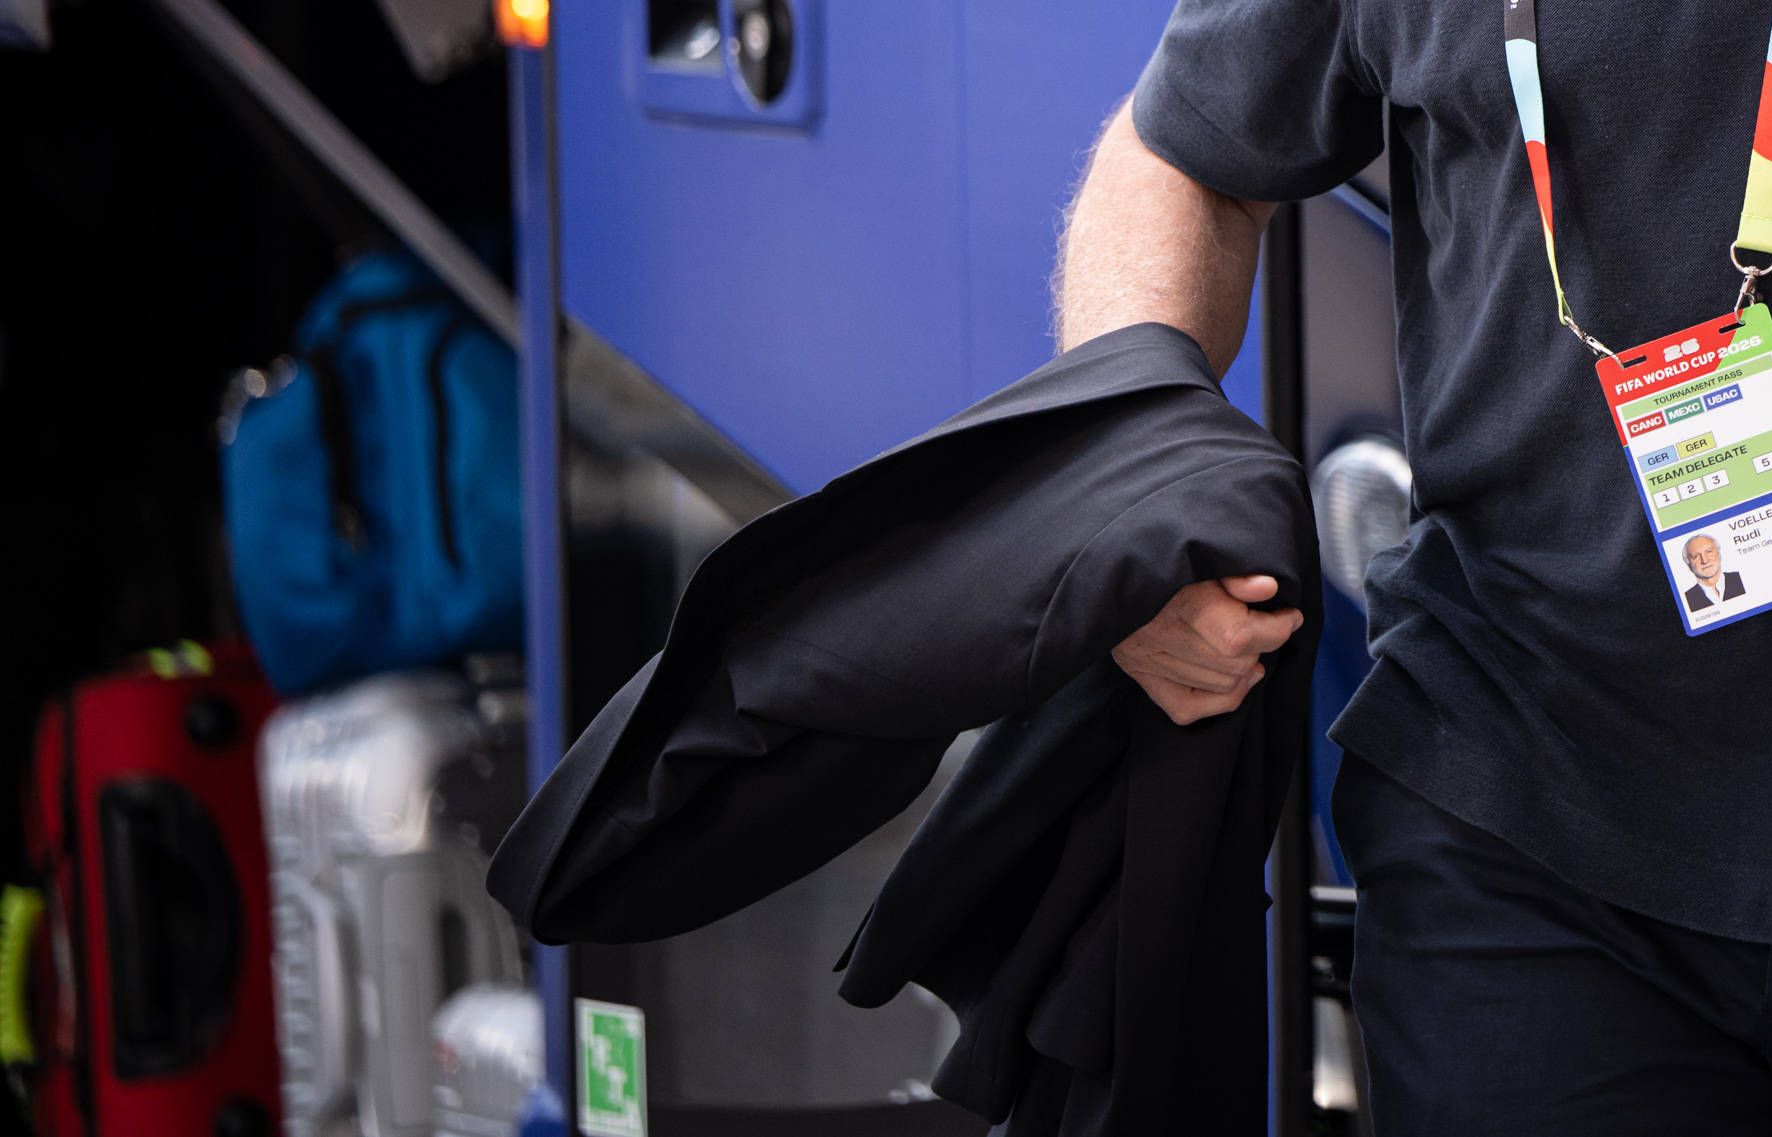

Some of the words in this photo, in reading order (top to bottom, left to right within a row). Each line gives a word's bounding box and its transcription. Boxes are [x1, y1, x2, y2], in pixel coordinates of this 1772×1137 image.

[1615, 380, 1645, 396] FIFA
[1643, 361, 1690, 385] WORLD
[1690, 351, 1716, 369] CUP
[1716, 335, 1763, 360] 2026
[1663, 338, 1700, 362] 26
[1653, 378, 1717, 406] TOURNAMENT
[1716, 369, 1743, 384] PASS
[1630, 415, 1663, 434] CANC
[1668, 402, 1701, 420] MEXC
[1708, 388, 1739, 406] USAC
[1647, 452, 1670, 466] GER
[1685, 438, 1708, 453] GER
[1648, 467, 1684, 486] TEAM
[1685, 444, 1748, 474] DELEGATE
[1662, 493, 1671, 502] 1
[1687, 484, 1696, 494] 2
[1711, 475, 1721, 485] 3
[1761, 458, 1770, 467] 5
[1733, 528, 1761, 545] Rudi
[1737, 543, 1761, 556] Team
